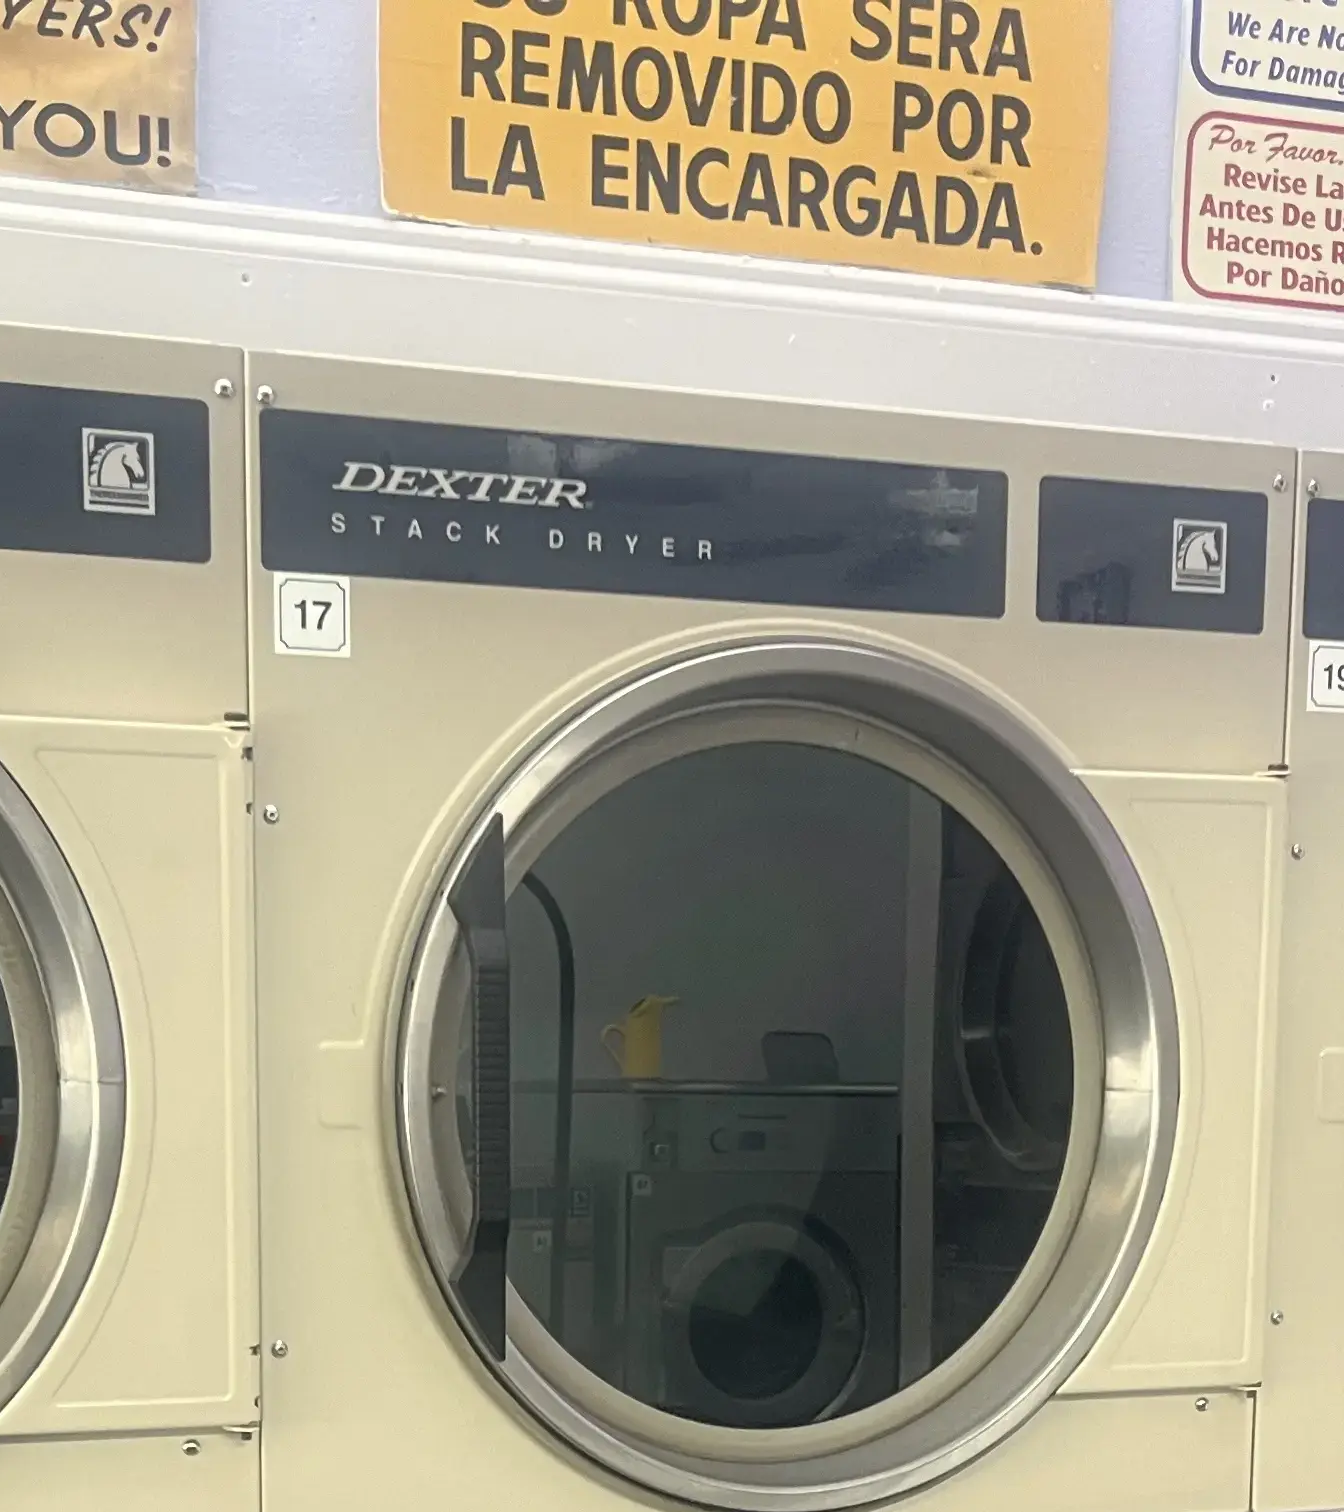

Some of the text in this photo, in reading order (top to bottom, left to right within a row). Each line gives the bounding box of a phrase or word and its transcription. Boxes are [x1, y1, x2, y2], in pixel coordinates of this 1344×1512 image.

[850, 0, 1032, 83] SERA
[1228, 11, 1261, 39] We
[1268, 18, 1311, 46] Are
[1221, 50, 1261, 78] For
[460, 22, 1031, 168] REMOVIDO POR
[1208, 124, 1256, 151] Por
[450, 116, 1042, 256] LA ENCARGADA.
[1223, 163, 1307, 195] Revise
[1199, 194, 1274, 224] Antes
[1282, 203, 1316, 229] De
[1206, 226, 1322, 262] Hacemos
[1227, 261, 1272, 288] Por
[332, 461, 588, 510] DEXTER
[331, 513, 713, 561] STACK DRYER
[293, 599, 333, 632] 17
